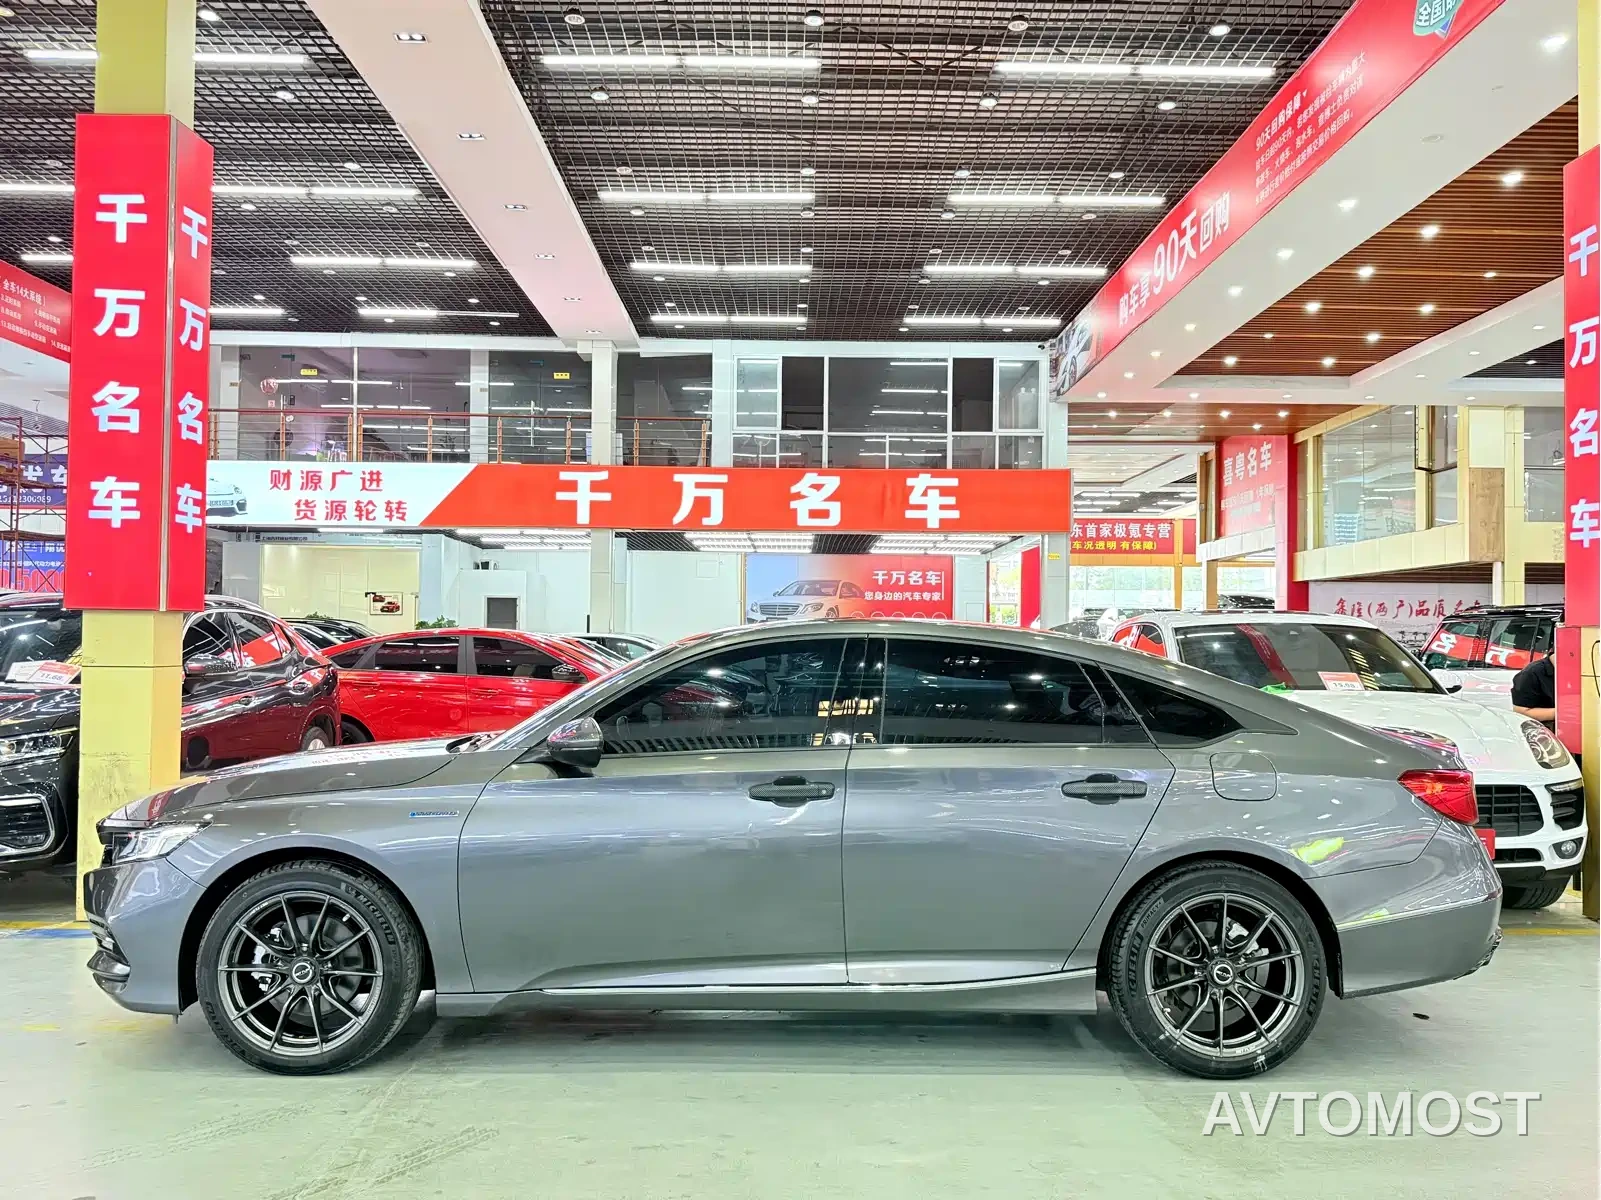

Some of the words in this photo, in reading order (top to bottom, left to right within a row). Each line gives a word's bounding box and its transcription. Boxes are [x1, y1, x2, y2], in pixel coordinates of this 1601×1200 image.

[1119, 190, 1231, 328] 购车享90天回购
[88, 193, 148, 528] 千万名车
[175, 206, 208, 534] 千万名车
[1568, 226, 1601, 548] 千万名车
[269, 469, 384, 492] 财源广进
[556, 470, 961, 529] 千万名车
[295, 498, 408, 522] 货源轮转
[863, 590, 942, 602] 您身边的汽车专家
[872, 570, 942, 586] 千万名车
[356, 892, 397, 944] MICHELIN
